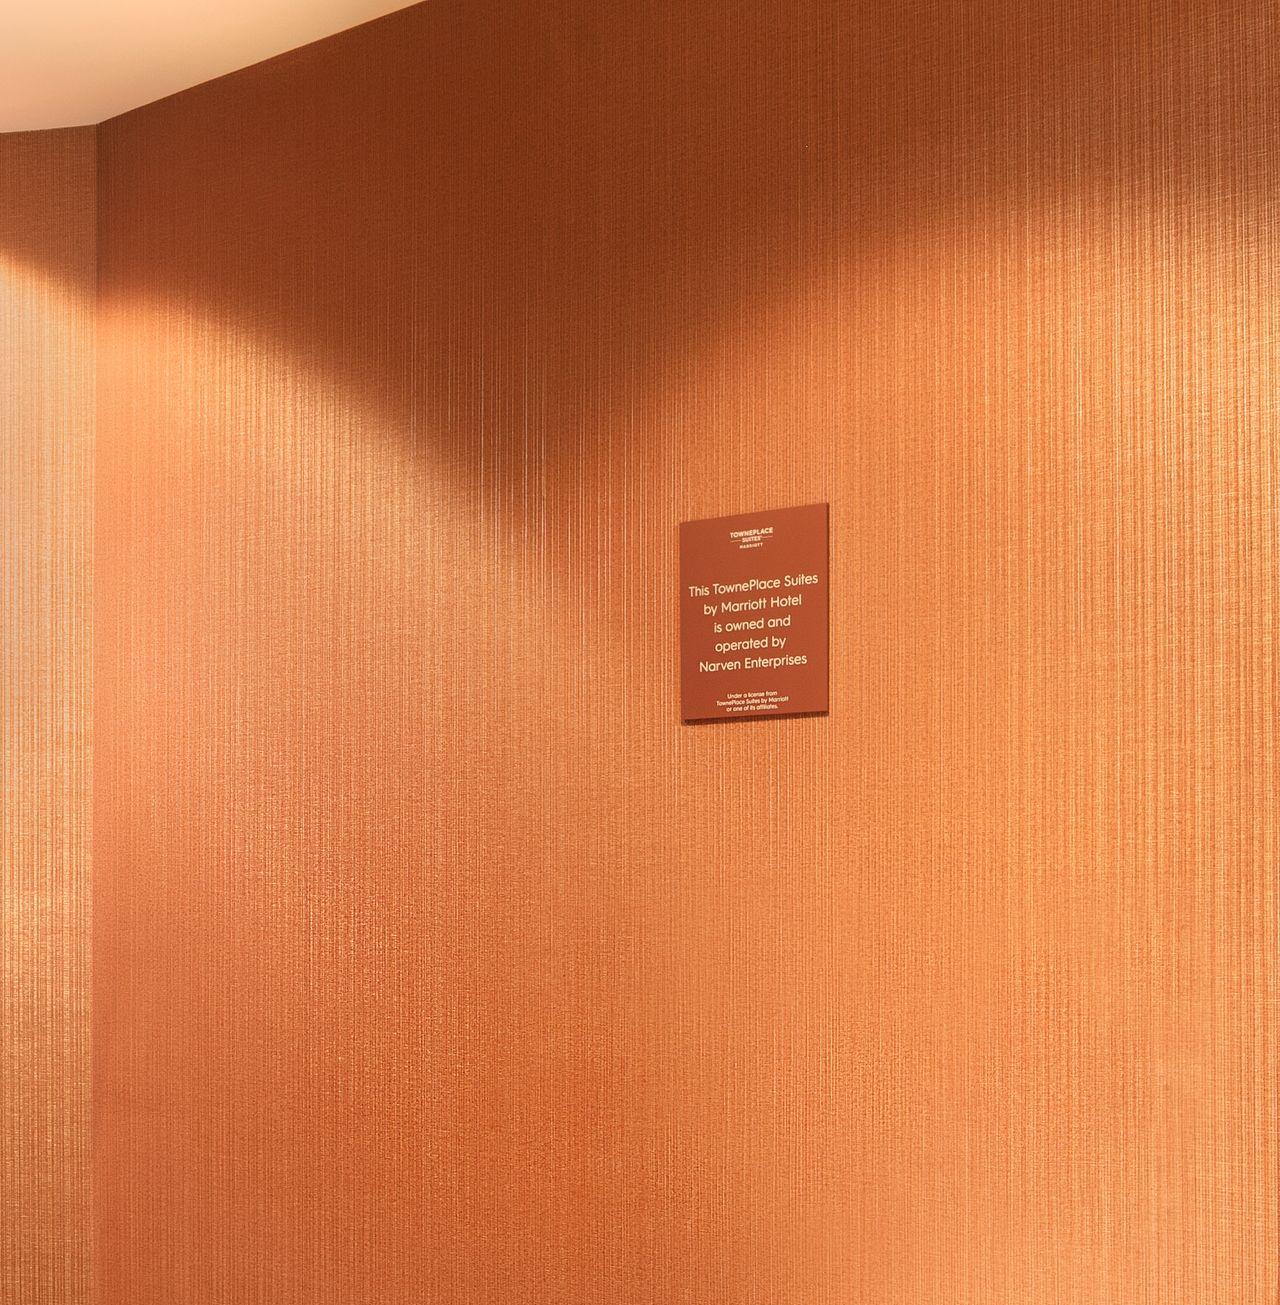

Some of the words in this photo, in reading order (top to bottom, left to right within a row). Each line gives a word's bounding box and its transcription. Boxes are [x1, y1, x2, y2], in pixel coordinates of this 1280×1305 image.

[729, 526, 774, 539] TOWNEPLACE
[688, 585, 710, 598] This
[712, 578, 781, 595] TownePlace
[784, 573, 819, 588] Suites
[703, 603, 718, 616] by
[721, 597, 767, 613] Marriott
[770, 594, 802, 608] Hotel
[713, 622, 723, 633] is
[725, 618, 765, 632] owned
[767, 615, 791, 628] and
[714, 637, 769, 654] operated
[771, 636, 787, 649] by
[699, 659, 741, 673] Narven
[744, 653, 808, 669] Enterprises
